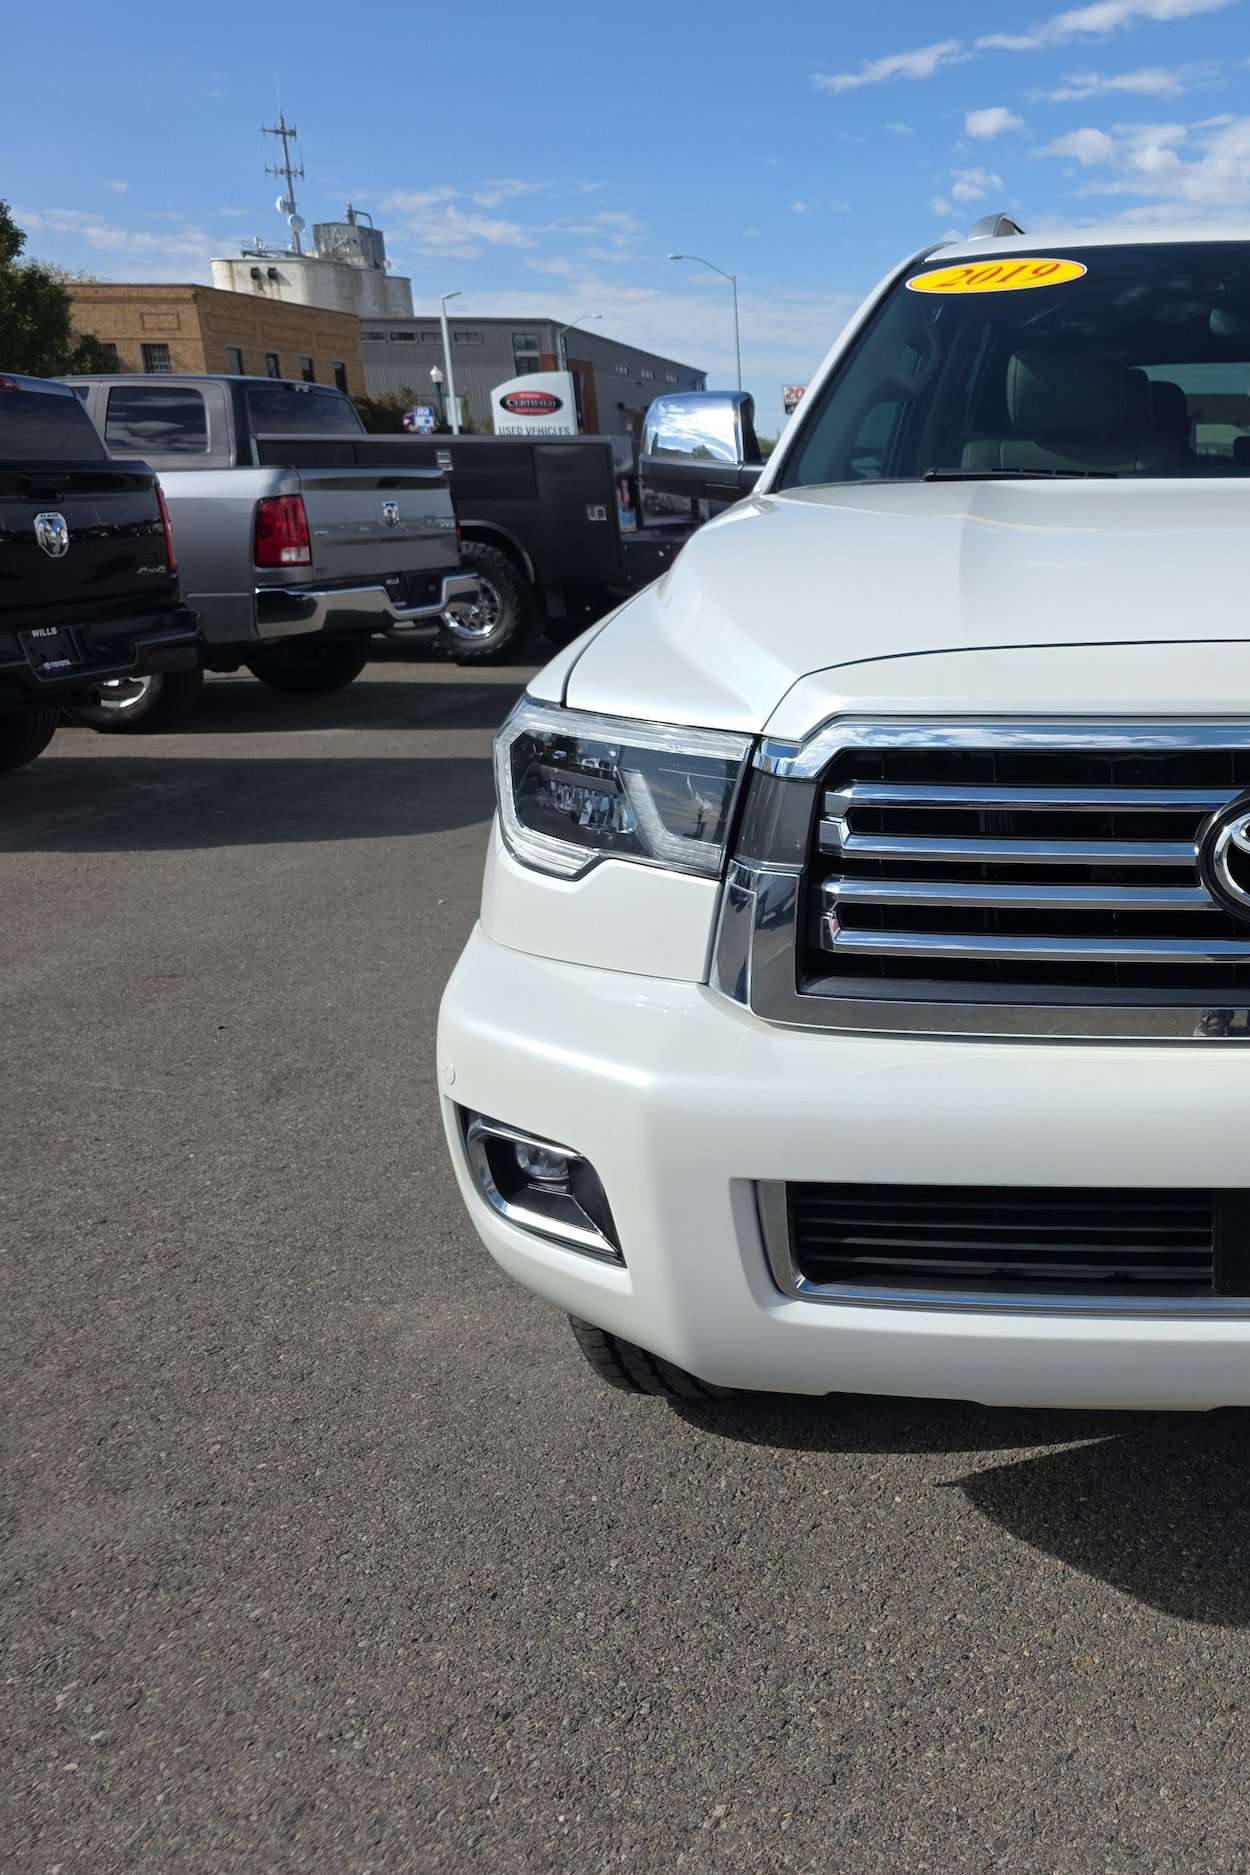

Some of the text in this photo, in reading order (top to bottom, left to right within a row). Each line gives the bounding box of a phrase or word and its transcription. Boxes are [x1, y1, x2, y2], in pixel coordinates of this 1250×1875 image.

[934, 262, 1061, 288] 2019
[499, 426, 571, 435] USED VEHICLES
[31, 626, 58, 638] WILLS
